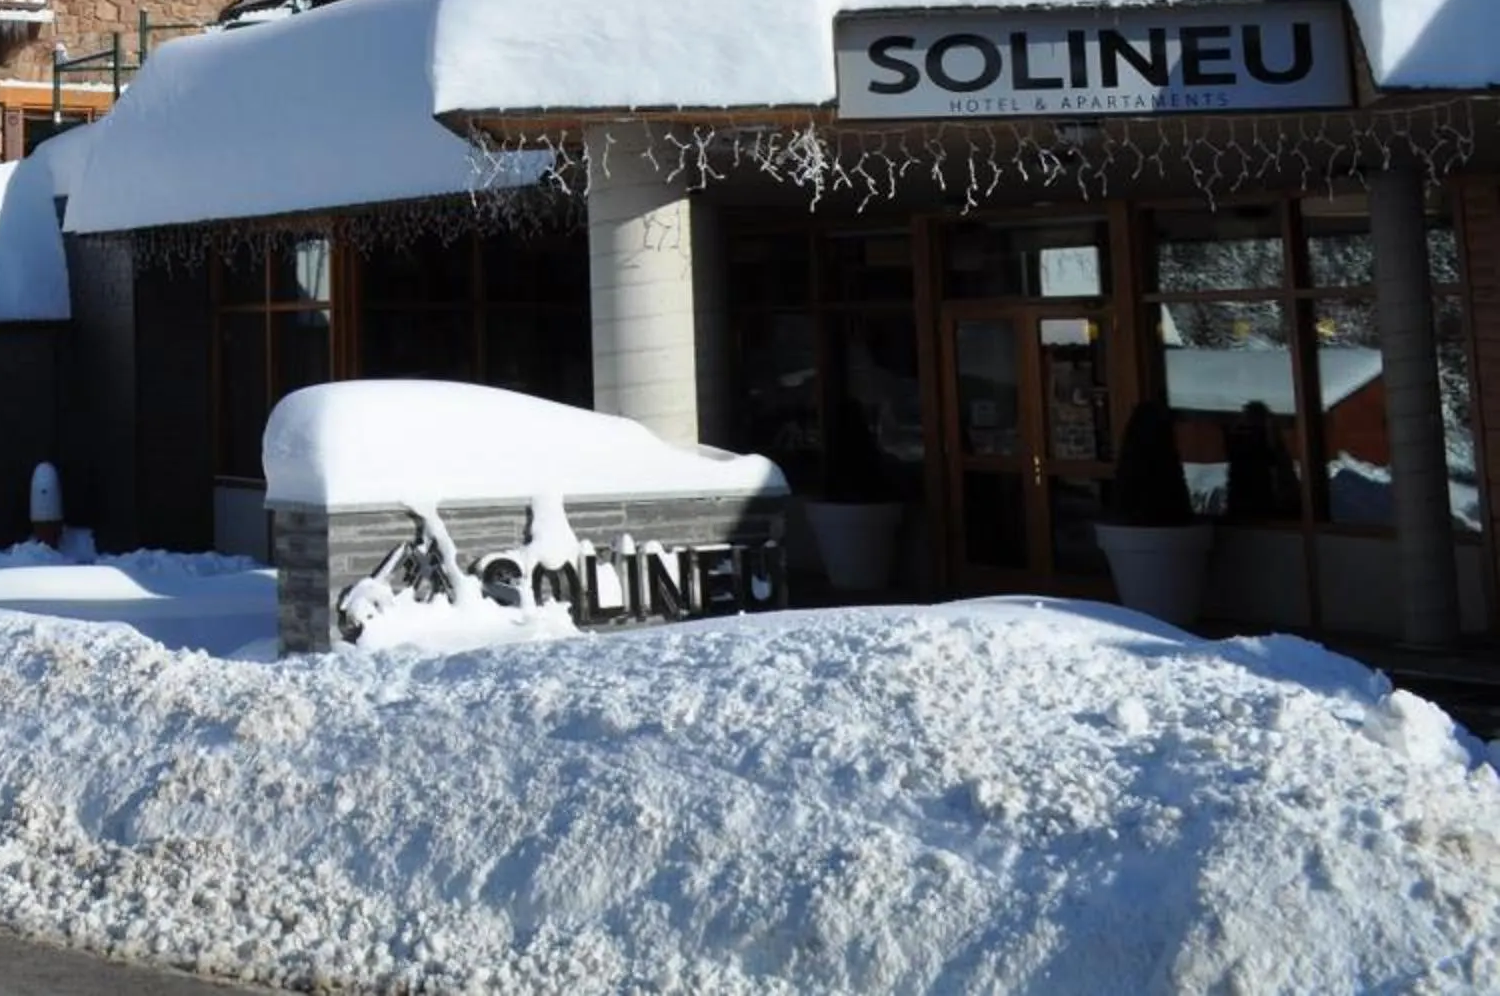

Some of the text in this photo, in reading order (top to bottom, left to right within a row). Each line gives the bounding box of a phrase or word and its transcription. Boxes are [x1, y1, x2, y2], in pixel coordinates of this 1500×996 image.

[867, 22, 1314, 94] SOLINEU
[950, 98, 1020, 113] HOTEL
[1060, 92, 1231, 110] APARTAMENTS
